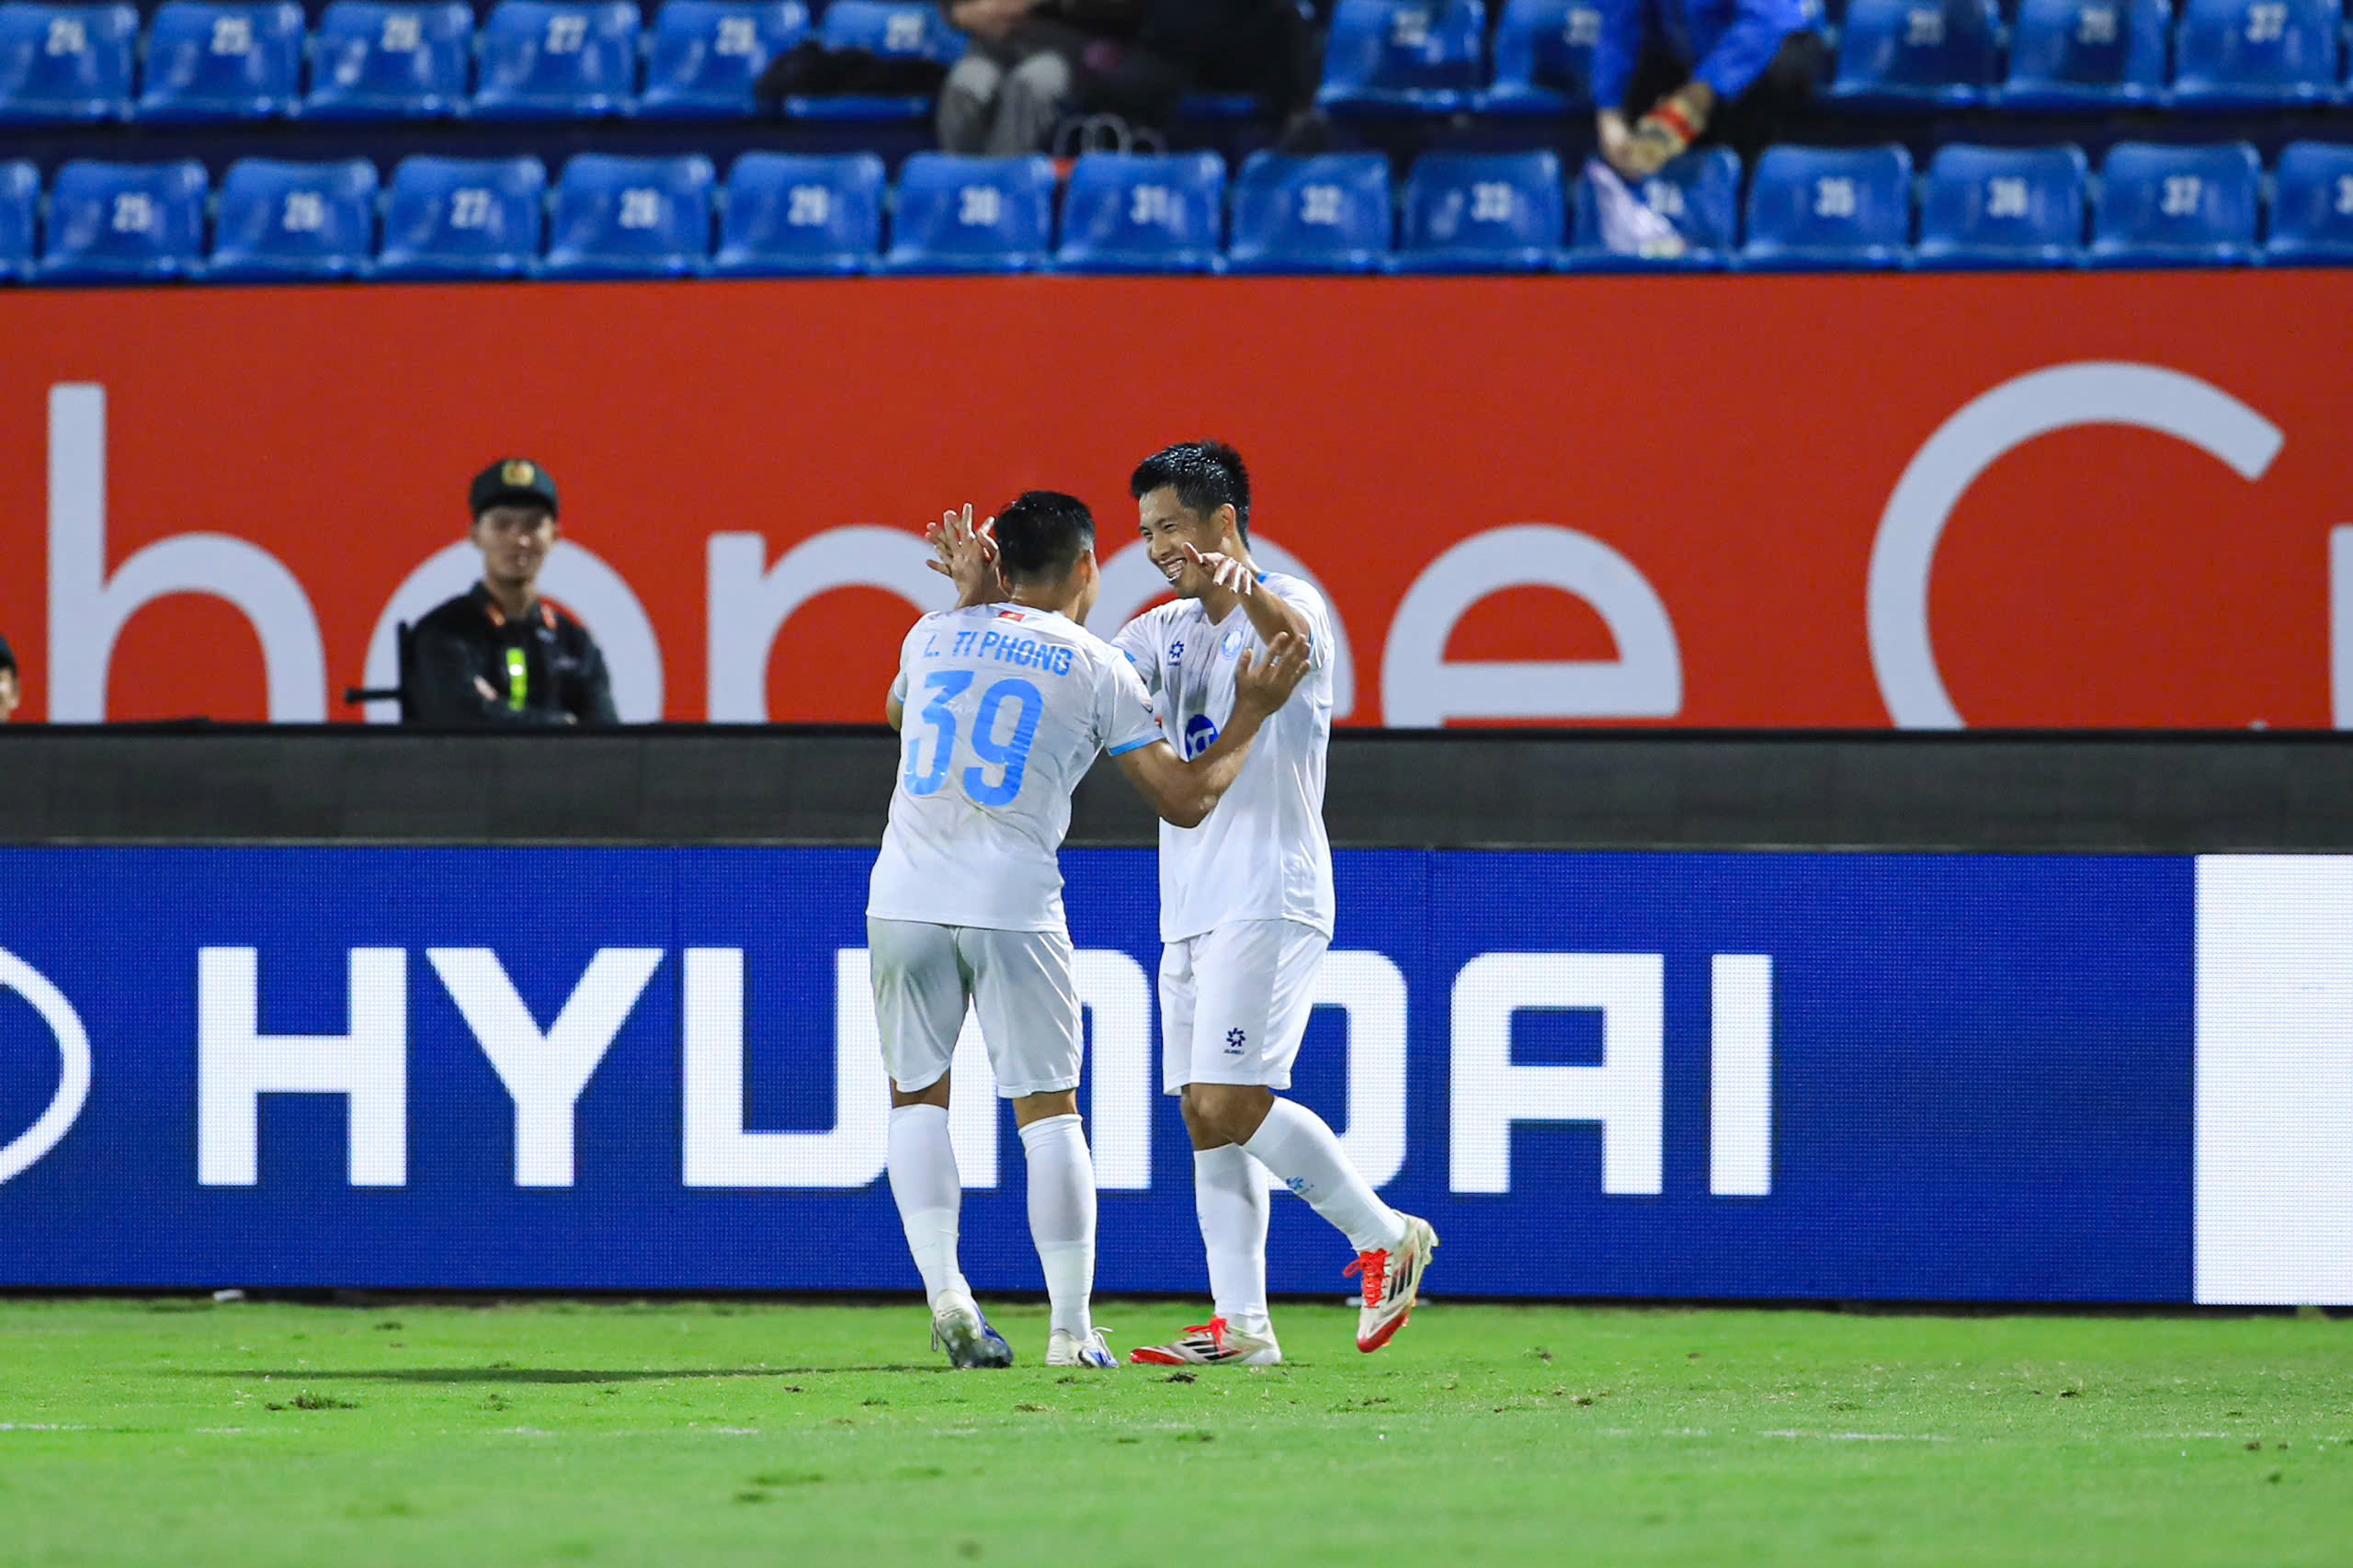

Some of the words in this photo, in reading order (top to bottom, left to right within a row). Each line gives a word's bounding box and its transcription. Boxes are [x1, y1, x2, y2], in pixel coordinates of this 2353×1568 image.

[450, 189, 491, 228] 27
[2336, 175, 2353, 215] 3
[923, 632, 940, 658] L.
[903, 669, 1044, 808] 39
